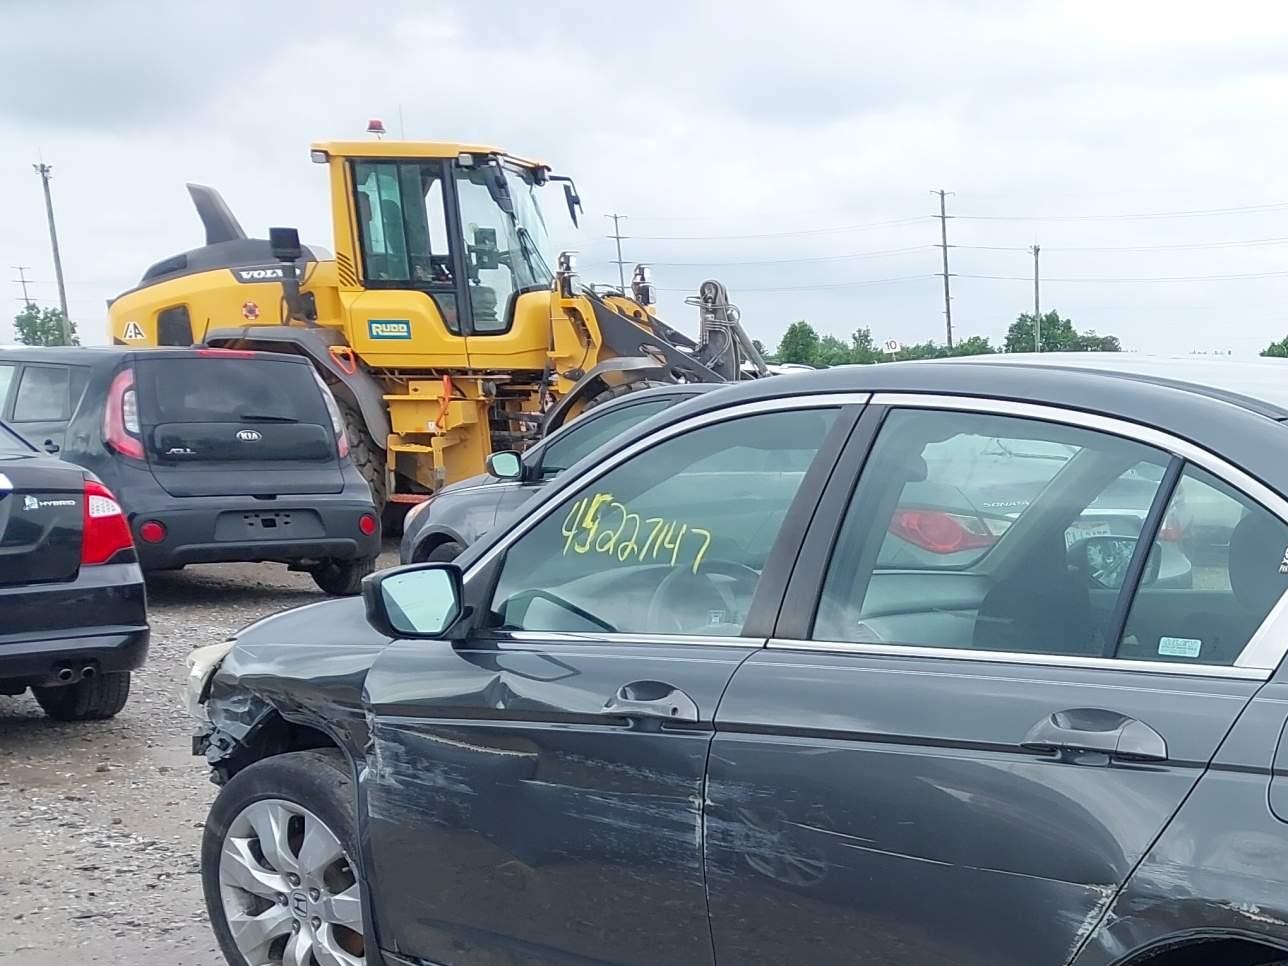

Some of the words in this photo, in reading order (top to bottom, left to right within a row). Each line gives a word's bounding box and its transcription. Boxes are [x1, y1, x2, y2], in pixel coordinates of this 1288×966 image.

[371, 323, 409, 336] RUDD
[240, 432, 259, 440] KIA
[561, 492, 712, 576] 45227147
